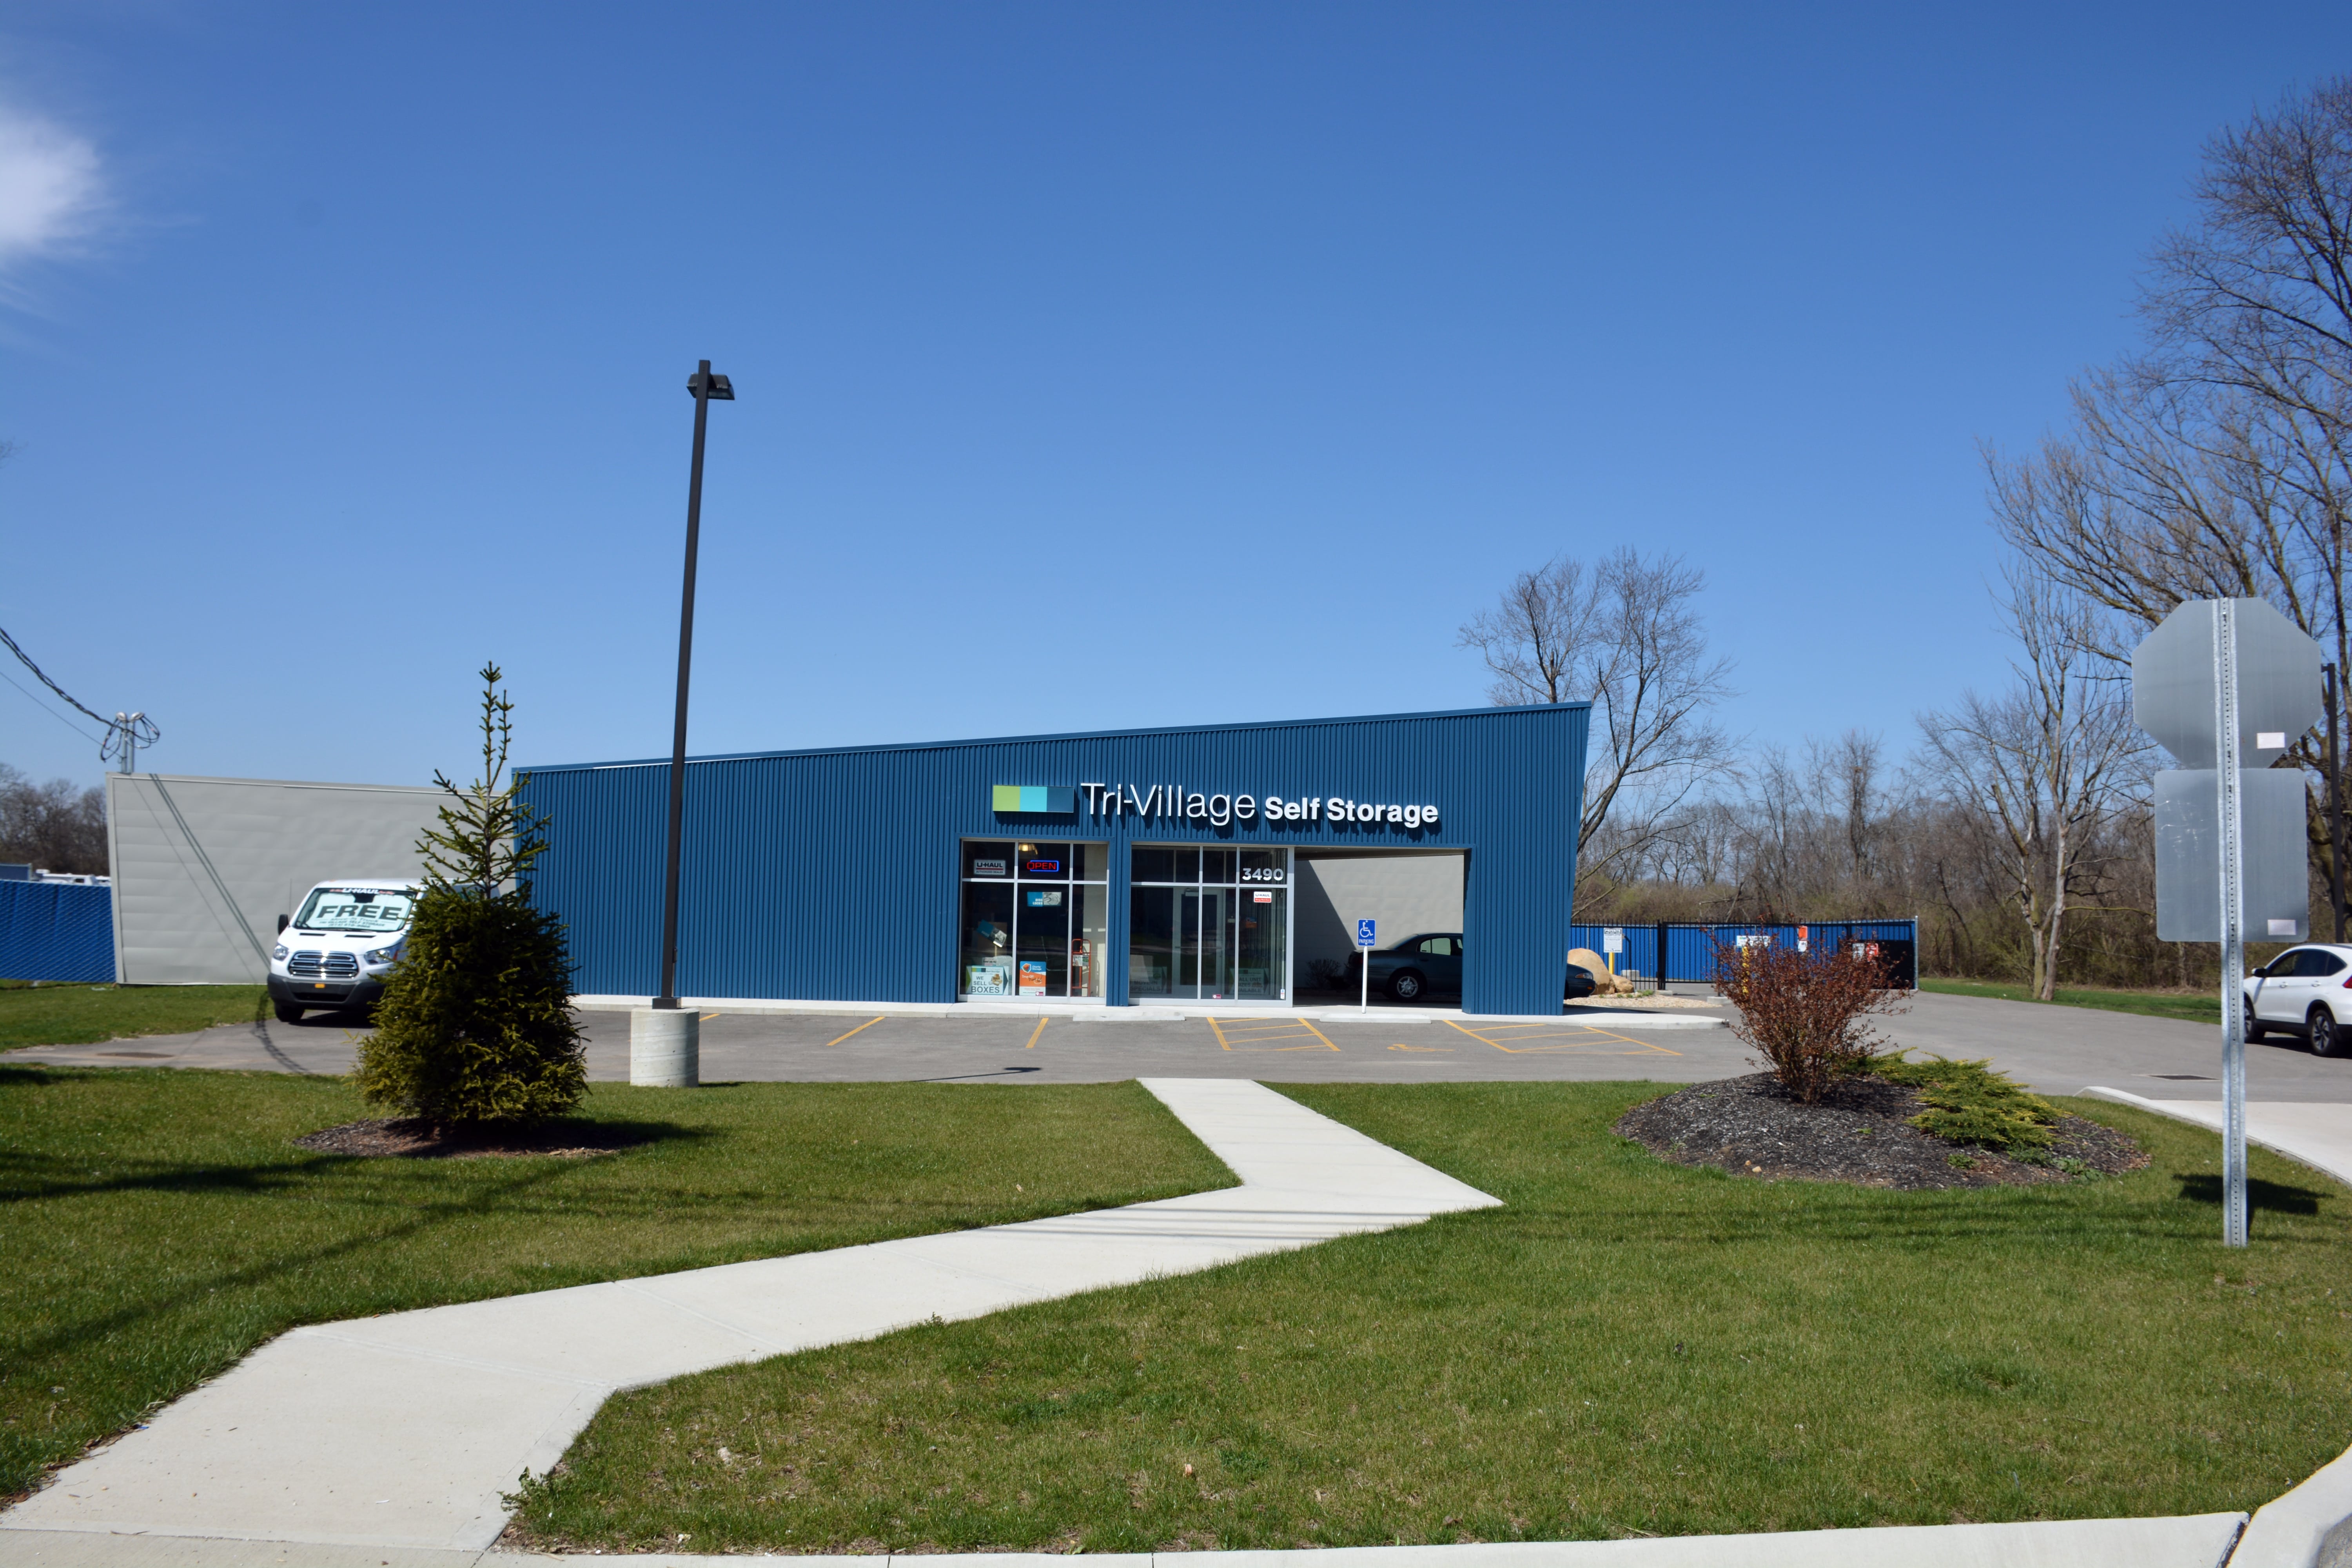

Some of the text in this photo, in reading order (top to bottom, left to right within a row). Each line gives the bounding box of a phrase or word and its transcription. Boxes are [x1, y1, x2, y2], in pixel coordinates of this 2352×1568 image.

[1081, 783, 1438, 828] Tri-Village Self Storage
[1242, 868, 1284, 881] 3490
[316, 905, 403, 920] FREE
